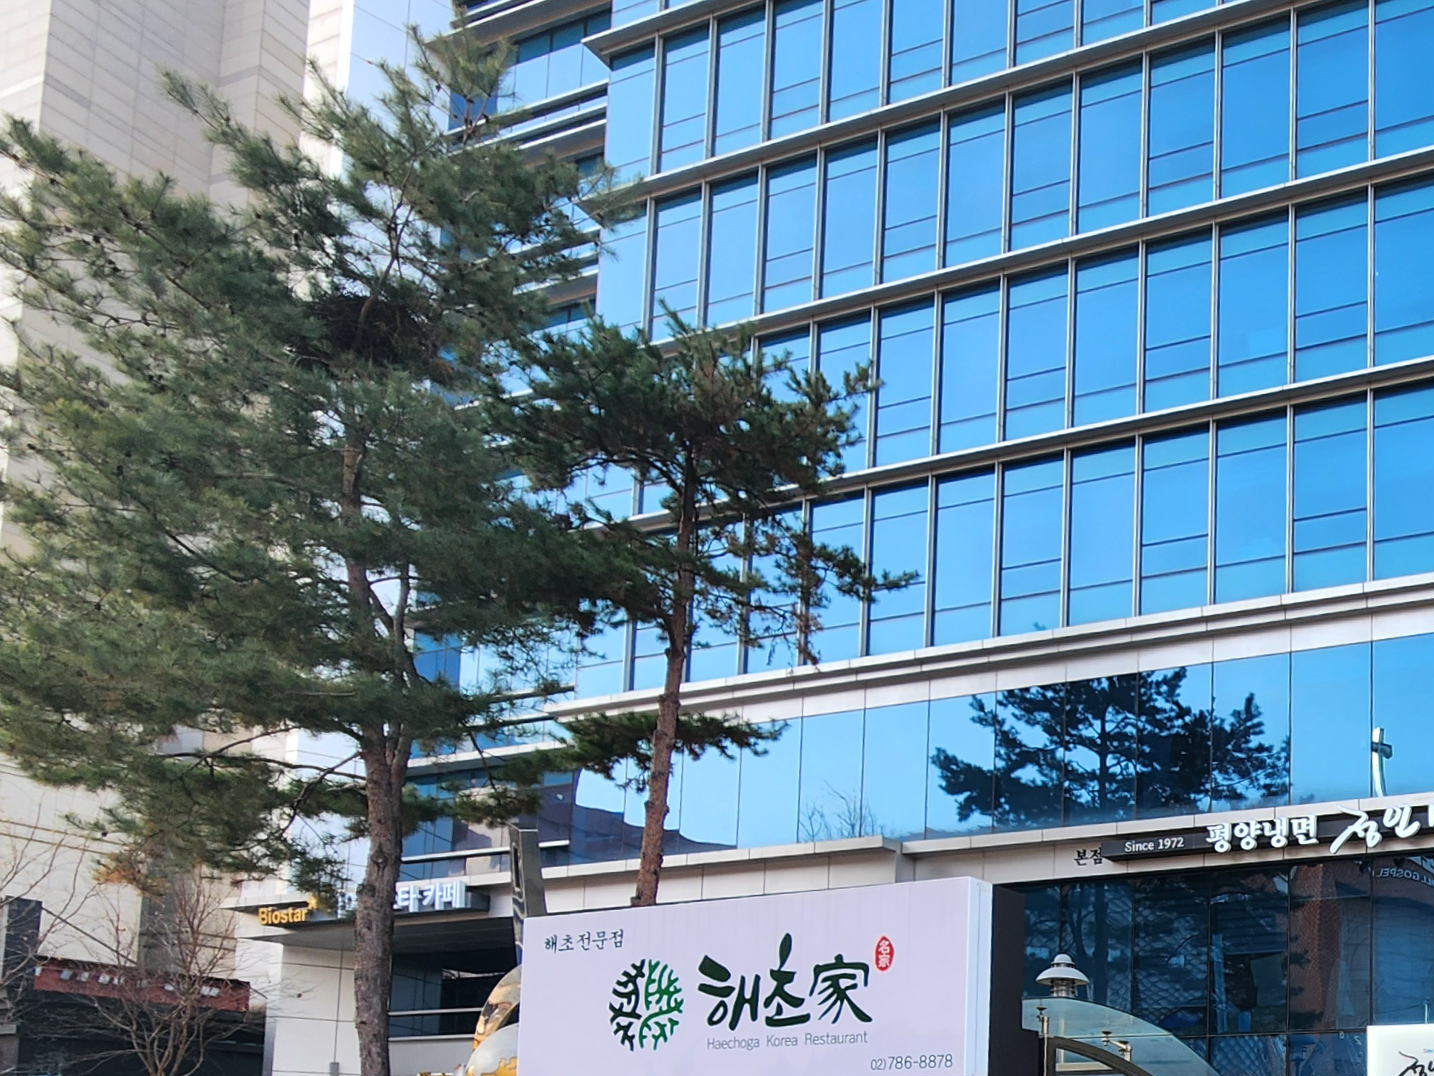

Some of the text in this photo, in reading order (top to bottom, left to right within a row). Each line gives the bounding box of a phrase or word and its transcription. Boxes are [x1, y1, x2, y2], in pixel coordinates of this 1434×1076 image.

[1206, 814, 1319, 853] 평양냉면
[1125, 838, 1184, 852] Since 1972
[1074, 847, 1103, 866] 본점
[258, 907, 308, 925] Biostar
[544, 929, 624, 954] 해초전문점
[698, 932, 873, 1032] 해초家
[707, 1031, 868, 1050] Haechoga Korea Restaurant
